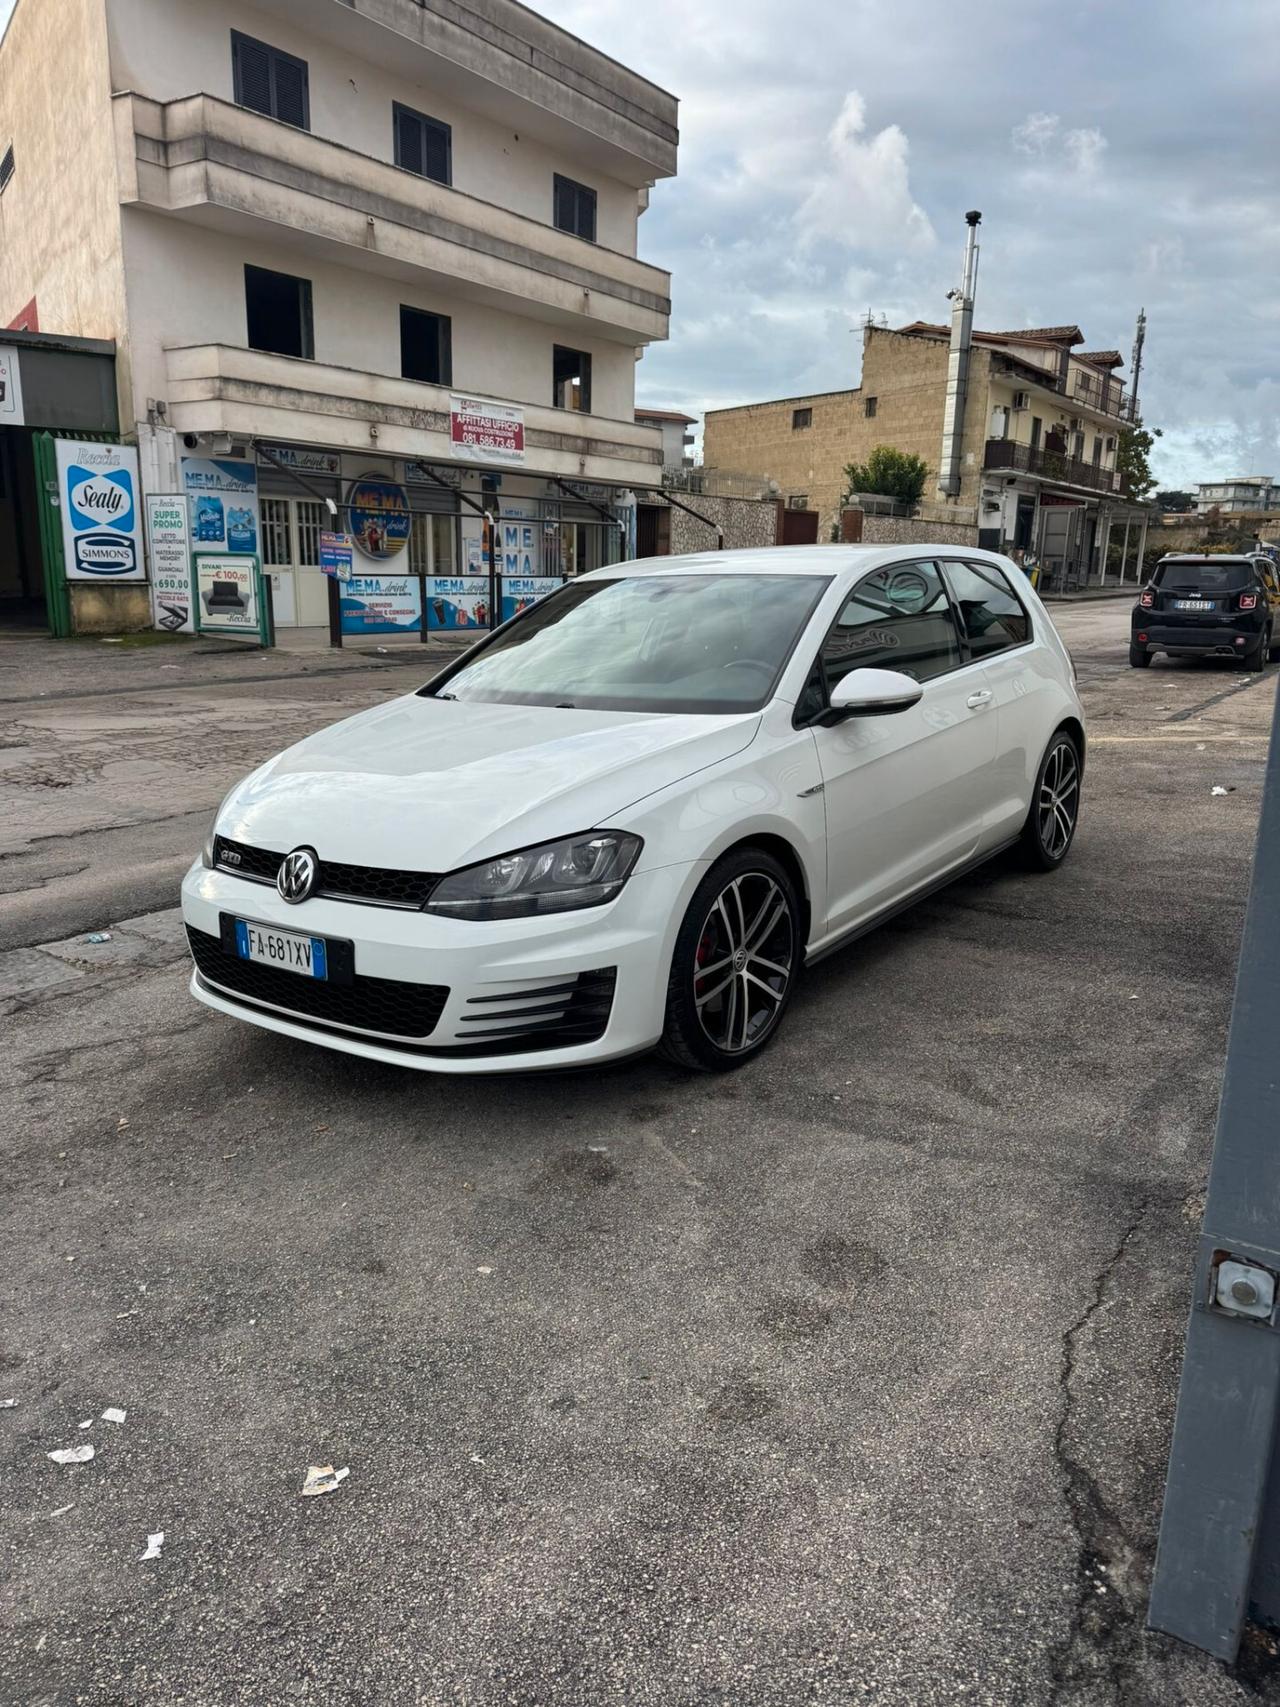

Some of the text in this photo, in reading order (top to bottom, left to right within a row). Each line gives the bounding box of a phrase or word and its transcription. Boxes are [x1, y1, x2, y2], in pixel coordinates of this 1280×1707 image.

[457, 414, 519, 432] AFFITTASI UFFICIO
[78, 484, 123, 513] Sealy
[154, 510, 181, 520] SUPER
[153, 519, 183, 529] PROMO
[81, 548, 130, 559] SIMMONS
[155, 549, 185, 557] MATERASSO
[201, 563, 222, 571] DIVANI
[159, 579, 189, 590] 690,00
[220, 849, 242, 865] GTD
